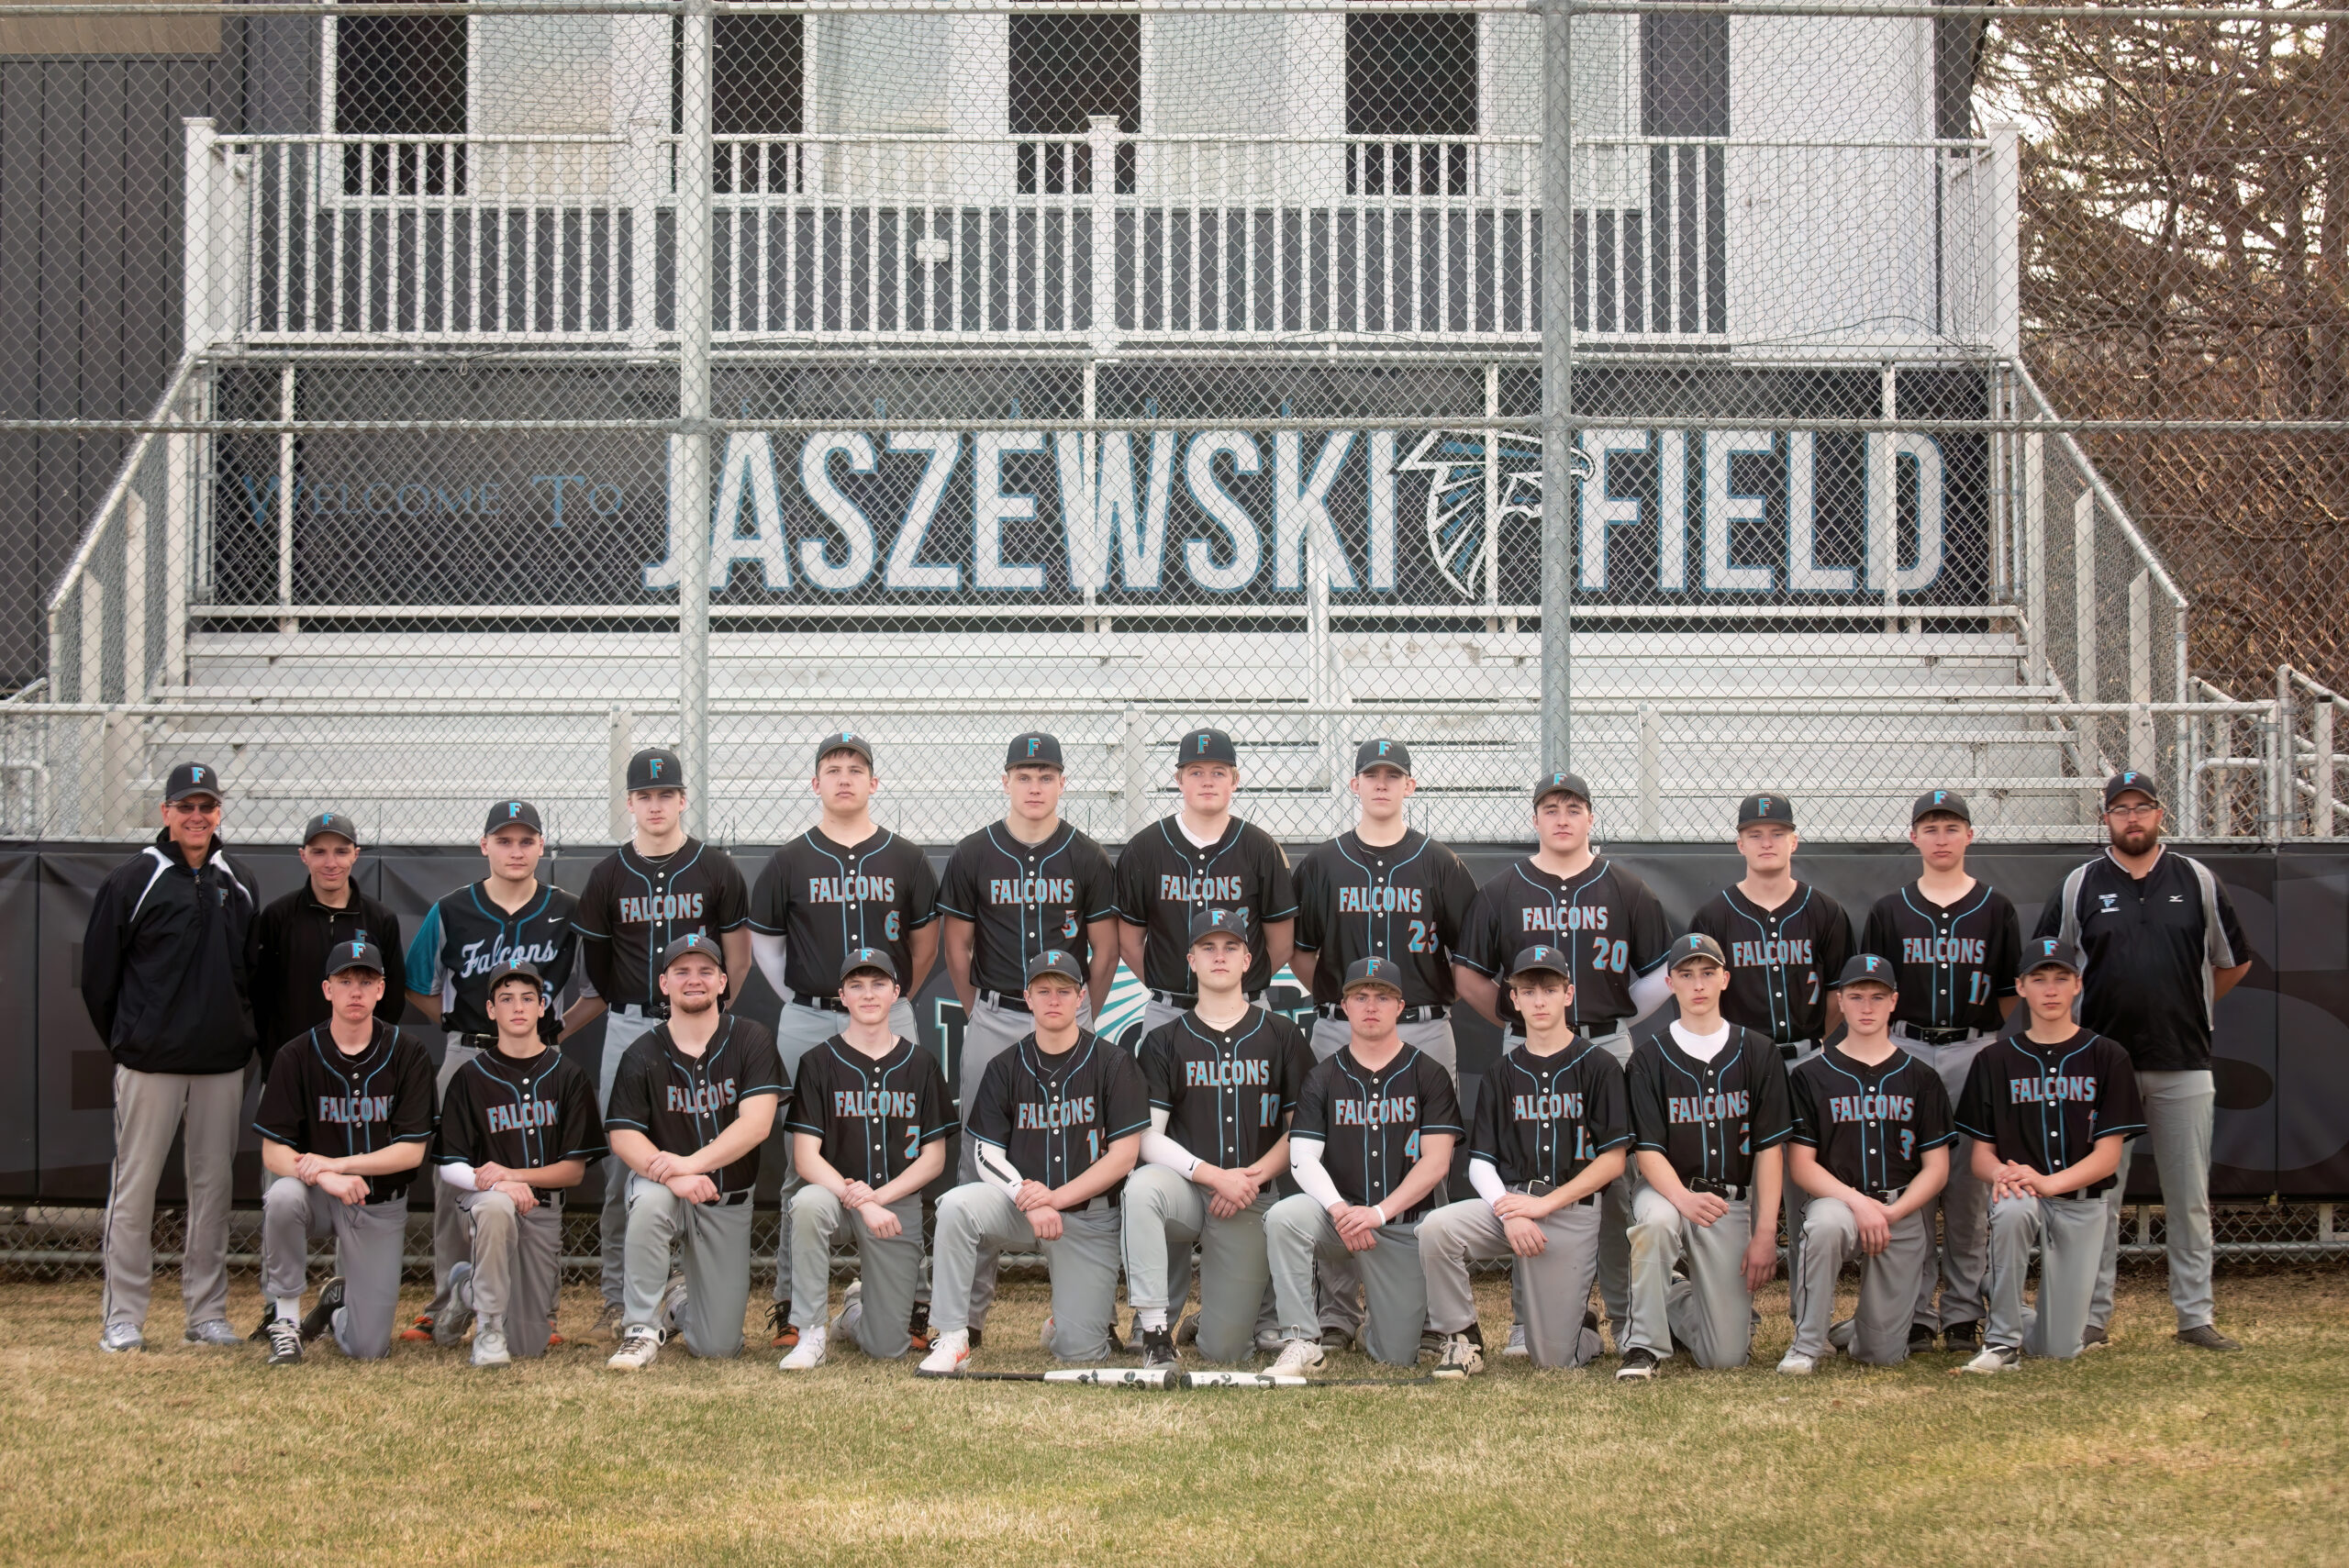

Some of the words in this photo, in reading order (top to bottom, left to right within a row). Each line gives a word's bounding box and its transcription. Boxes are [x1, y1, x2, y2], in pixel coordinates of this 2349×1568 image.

[642, 429, 1397, 594] JASZEWSKI
[1576, 429, 1946, 595] FIELD
[841, 732, 854, 744] F
[1026, 738, 1041, 758] F
[1197, 734, 1211, 754] F
[1378, 740, 1392, 757] F
[191, 766, 206, 784] F
[650, 758, 664, 779] F
[1553, 773, 1567, 786] F
[2122, 771, 2139, 784] F
[508, 801, 520, 818] F
[1757, 797, 1772, 817] F
[1932, 790, 1948, 805] F
[321, 813, 336, 827] F
[809, 875, 895, 903] FALCONS
[990, 878, 1074, 905] FALCONS
[1160, 874, 1242, 902] FALCONS
[1339, 886, 1422, 913] FALCONS
[619, 893, 704, 923] FALCONS
[1210, 910, 1226, 926] F
[1522, 906, 1609, 931] FALCONS
[884, 909, 900, 941] 6
[1061, 909, 1079, 940] 5
[351, 941, 366, 959] F
[685, 933, 700, 948] F
[1688, 935, 1703, 949] F
[1732, 939, 1813, 967] FALCONS
[1902, 937, 1986, 964] FALCONS
[2043, 939, 2059, 956] F
[461, 933, 559, 978] Falcons
[508, 959, 523, 971] F
[859, 948, 874, 962] F
[1047, 950, 1062, 965] F
[1534, 946, 1549, 962] F
[1592, 936, 1630, 974] 20
[1865, 956, 1880, 972] F
[1366, 959, 1382, 976] F
[1968, 970, 1991, 1006] 17
[1186, 1059, 1270, 1086] FALCONS
[2009, 1076, 2097, 1105] FALCONS
[834, 1091, 916, 1119] FALCONS
[1018, 1095, 1096, 1129] FALCONS
[1334, 1095, 1416, 1126] FALCONS
[1512, 1093, 1584, 1121] ALCONS
[1667, 1089, 1749, 1124] FALCONS
[1829, 1095, 1914, 1123] FALCONS
[904, 1125, 920, 1160] 2
[1404, 1129, 1420, 1163] 4
[1899, 1129, 1916, 1161] 3
[631, 1326, 645, 1334] NIKE
